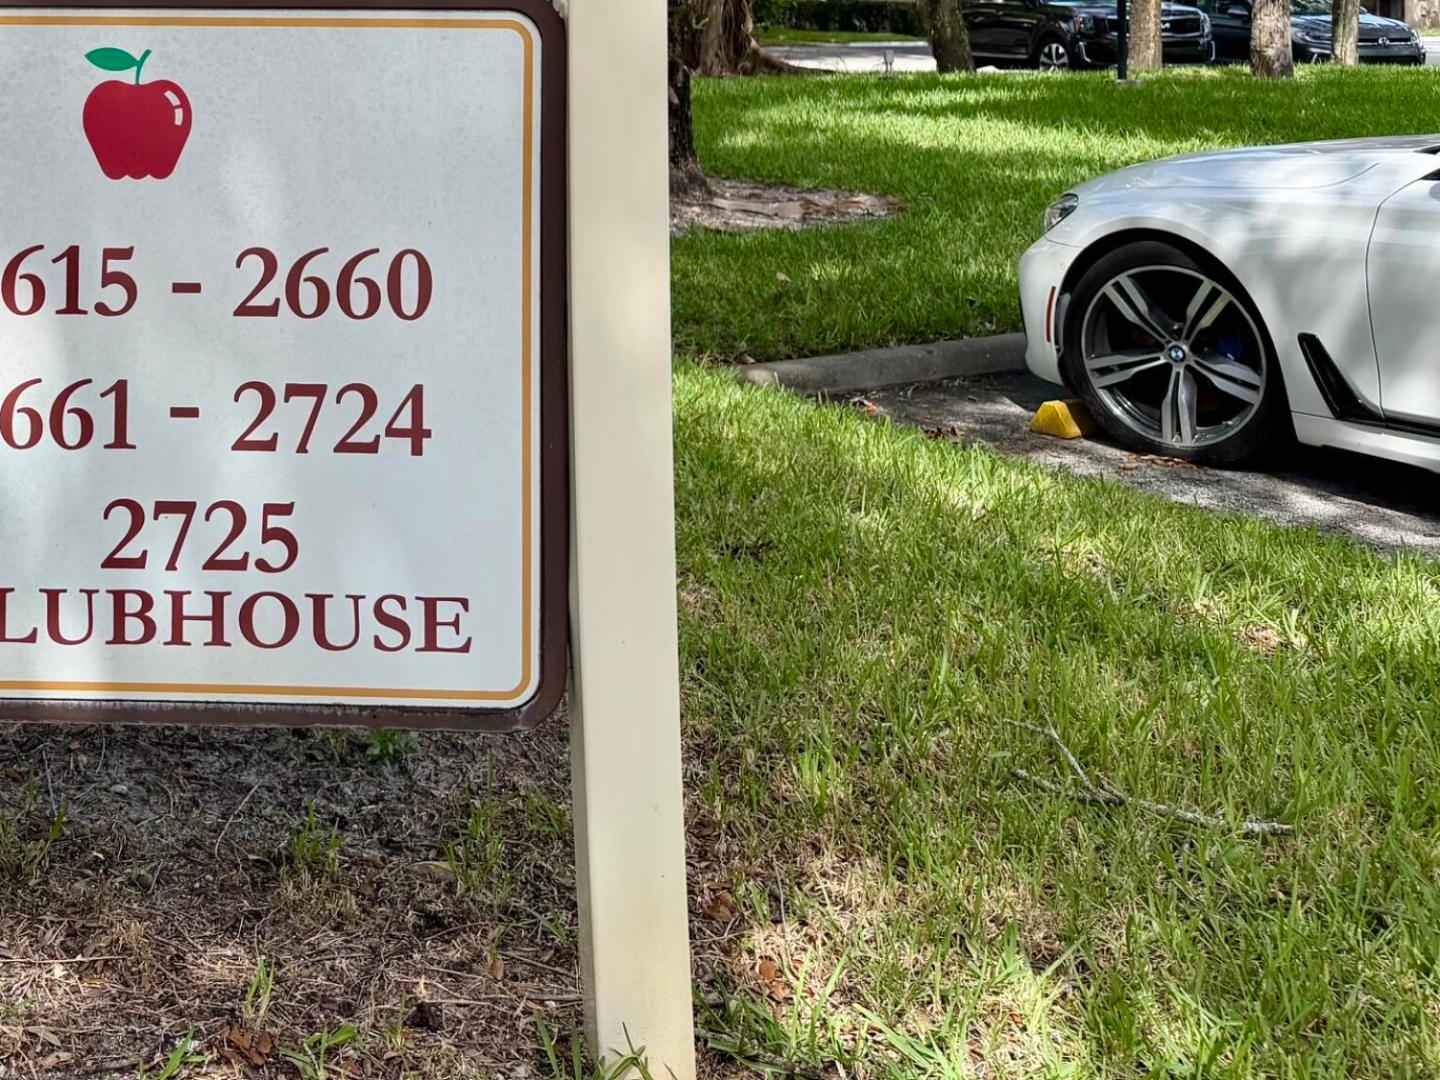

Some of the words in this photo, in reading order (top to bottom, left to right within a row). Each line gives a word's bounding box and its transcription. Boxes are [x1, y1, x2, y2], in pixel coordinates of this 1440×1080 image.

[171, 281, 202, 294] -
[234, 247, 433, 321] 2660
[169, 407, 200, 419] -
[232, 381, 432, 457] 2724
[101, 498, 298, 573] 2725
